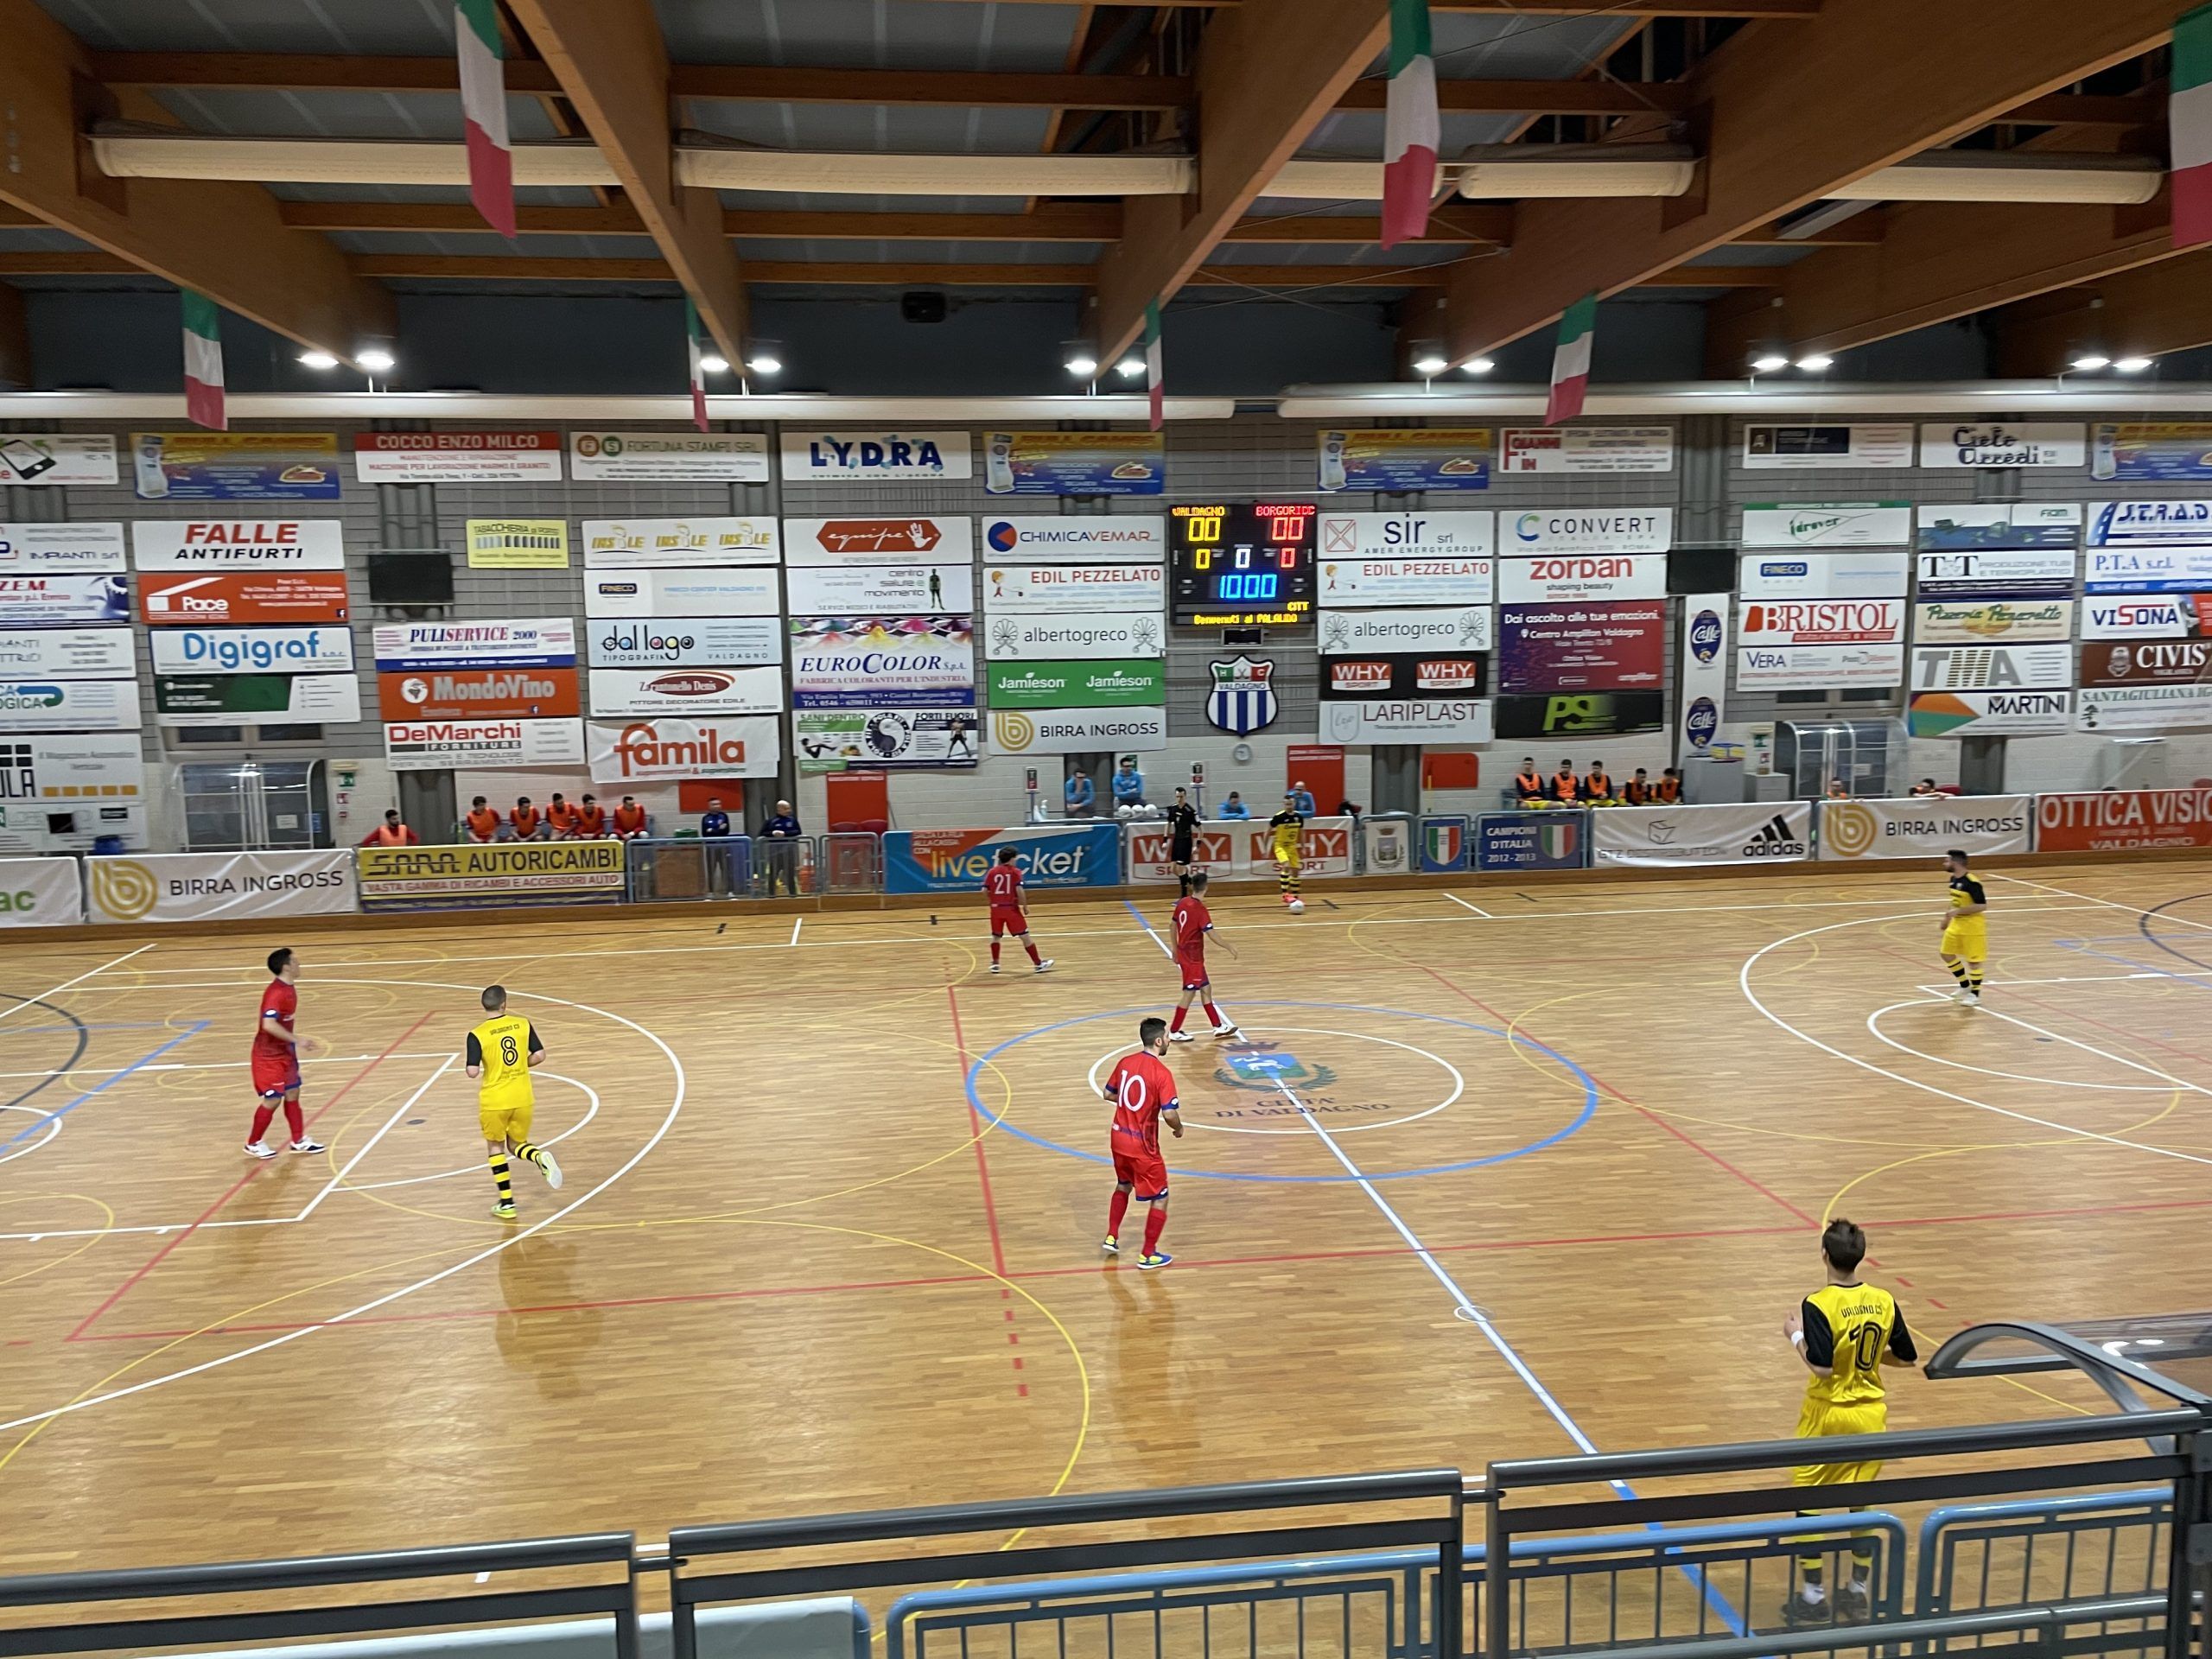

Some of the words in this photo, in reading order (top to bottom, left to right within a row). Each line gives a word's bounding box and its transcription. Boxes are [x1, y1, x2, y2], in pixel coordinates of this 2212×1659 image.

[377, 435, 433, 448] COCCO
[437, 435, 482, 448] ENZO
[486, 435, 539, 448] MILCO
[810, 442, 944, 467] LYDRA
[184, 524, 298, 544] FALLE
[1189, 518, 1220, 541] 00
[1272, 517, 1304, 540] 00
[1549, 518, 1656, 534] CONVERT
[827, 528, 904, 550] equipe
[1020, 531, 1150, 542] CHIMICAVEMAR
[1437, 533, 1452, 543] srl
[175, 548, 302, 559] ANTIFURTI
[1196, 549, 1211, 569] 0
[1236, 548, 1250, 569] 0
[1281, 548, 1295, 568] 0
[1032, 571, 1067, 583] EDIL
[1072, 569, 1160, 582] PEZZELATO
[1363, 565, 1398, 575] EDIL
[1403, 563, 1489, 575] PEZZELATO
[864, 588, 925, 597] movimento
[182, 596, 229, 611] Pace
[1504, 613, 1523, 624] Dai
[1525, 613, 1565, 623] ascolto
[1567, 612, 1586, 621] alle
[1767, 604, 1898, 632] BRISTOL
[410, 627, 508, 642] PULISERVICE
[512, 631, 537, 640] 2000
[1024, 627, 1128, 645] albertogreco
[1354, 622, 1455, 639] albertogreco
[183, 631, 319, 669] Digigraf
[2136, 644, 2206, 668] CIVIS
[1746, 652, 1786, 669] VERA
[1334, 665, 1389, 679] WHY
[1420, 664, 1471, 678] WHY
[433, 674, 555, 701] MondoVino
[998, 677, 1065, 689] Jamieson
[1086, 675, 1152, 687] Jamieson
[1363, 703, 1481, 721] LARIPLAST
[389, 723, 521, 742] DeMarchi
[1040, 726, 1085, 737] BIRRA
[1090, 723, 1158, 735] INGROSS
[430, 741, 520, 751] FORNITURE
[613, 723, 745, 777] famila
[2041, 793, 2145, 829] OTTICA
[1487, 826, 1536, 836] CAMPIONI
[1886, 821, 1937, 836] BIRRA
[1943, 817, 2023, 833] INGROSS
[1491, 841, 1533, 849] D'ITALIA
[1743, 842, 1804, 856] adidas
[2088, 836, 2196, 849] VALDAGNO
[468, 848, 617, 872] AUTORICAMBI
[170, 878, 235, 896] BIRRA
[243, 870, 344, 893] INGROSS
[366, 882, 403, 893] VASTA
[405, 881, 447, 892] GAMMA
[451, 880, 461, 890] DI
[463, 878, 510, 889] RICAMBI
[514, 878, 520, 887] E
[524, 876, 586, 886] ACCESSORI
[589, 874, 619, 885] AUTO
[995, 874, 1012, 894] 21
[1179, 910, 1187, 933] 9
[500, 1036, 518, 1066] 8
[1118, 1070, 1146, 1112] 10
[1251, 1103, 1391, 1115] VALDAGNO
[1849, 1321, 1883, 1370] 10
